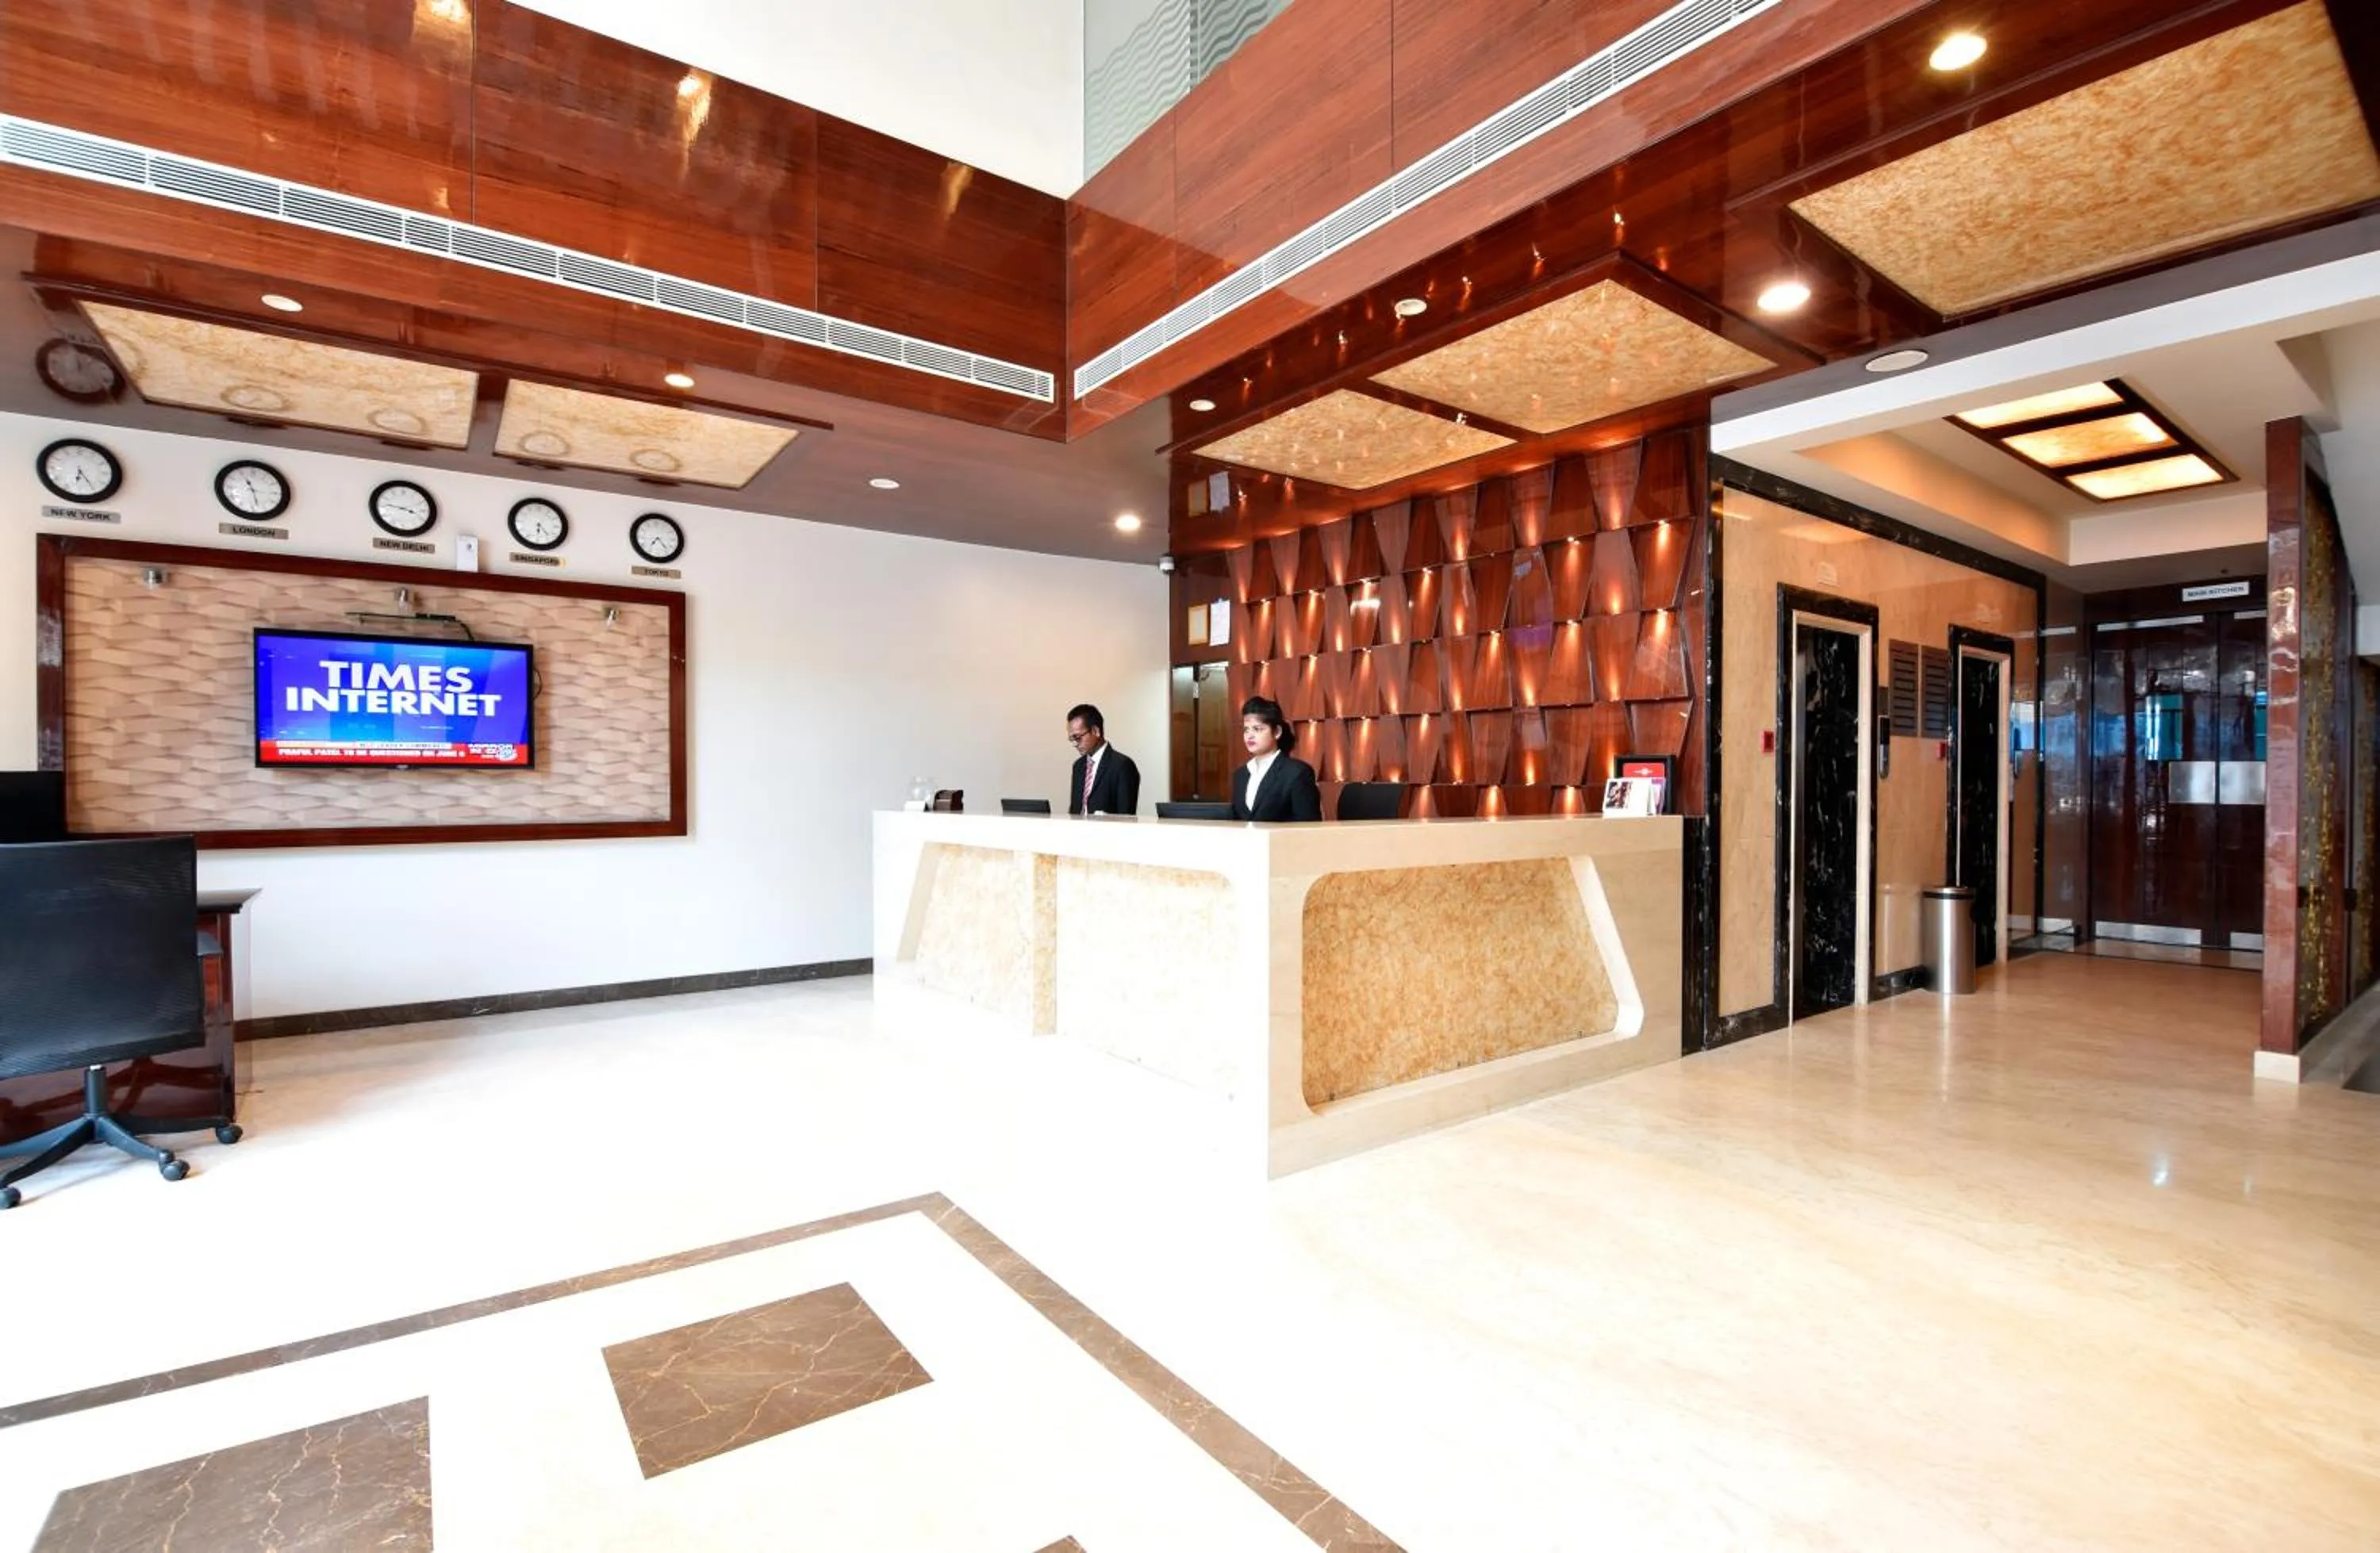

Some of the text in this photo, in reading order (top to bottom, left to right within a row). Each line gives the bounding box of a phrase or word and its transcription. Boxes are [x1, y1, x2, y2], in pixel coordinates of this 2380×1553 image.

[50, 508, 110, 521] NEW YORK
[232, 526, 275, 537] LONDON
[379, 540, 429, 551] NEW DELHI
[319, 660, 474, 693] TIMES
[286, 686, 502, 717] INTERNET
